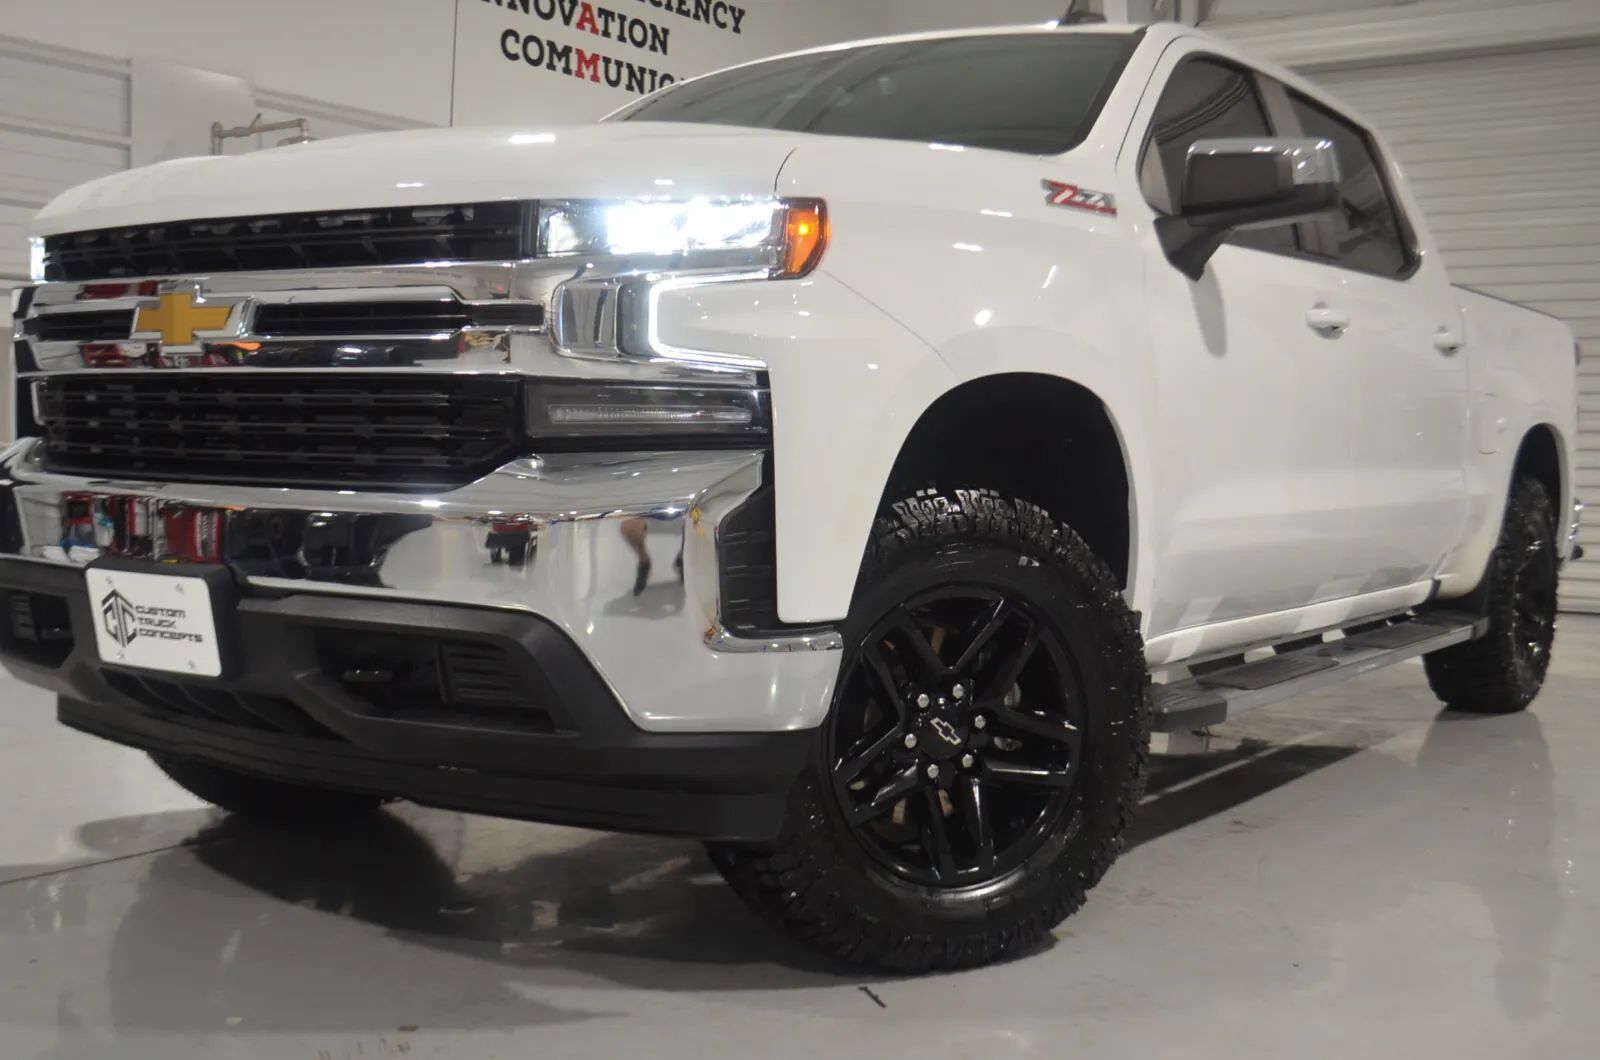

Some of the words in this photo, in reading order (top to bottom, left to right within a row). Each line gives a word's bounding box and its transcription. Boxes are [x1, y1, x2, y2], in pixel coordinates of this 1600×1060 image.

[481, 0, 670, 55] OVATION
[637, 0, 745, 34] ENCY
[501, 29, 678, 94] COMMUNI
[135, 605, 186, 619] CUSTOM
[137, 617, 177, 630] TRUCK
[139, 628, 203, 643] CONCEPTS
